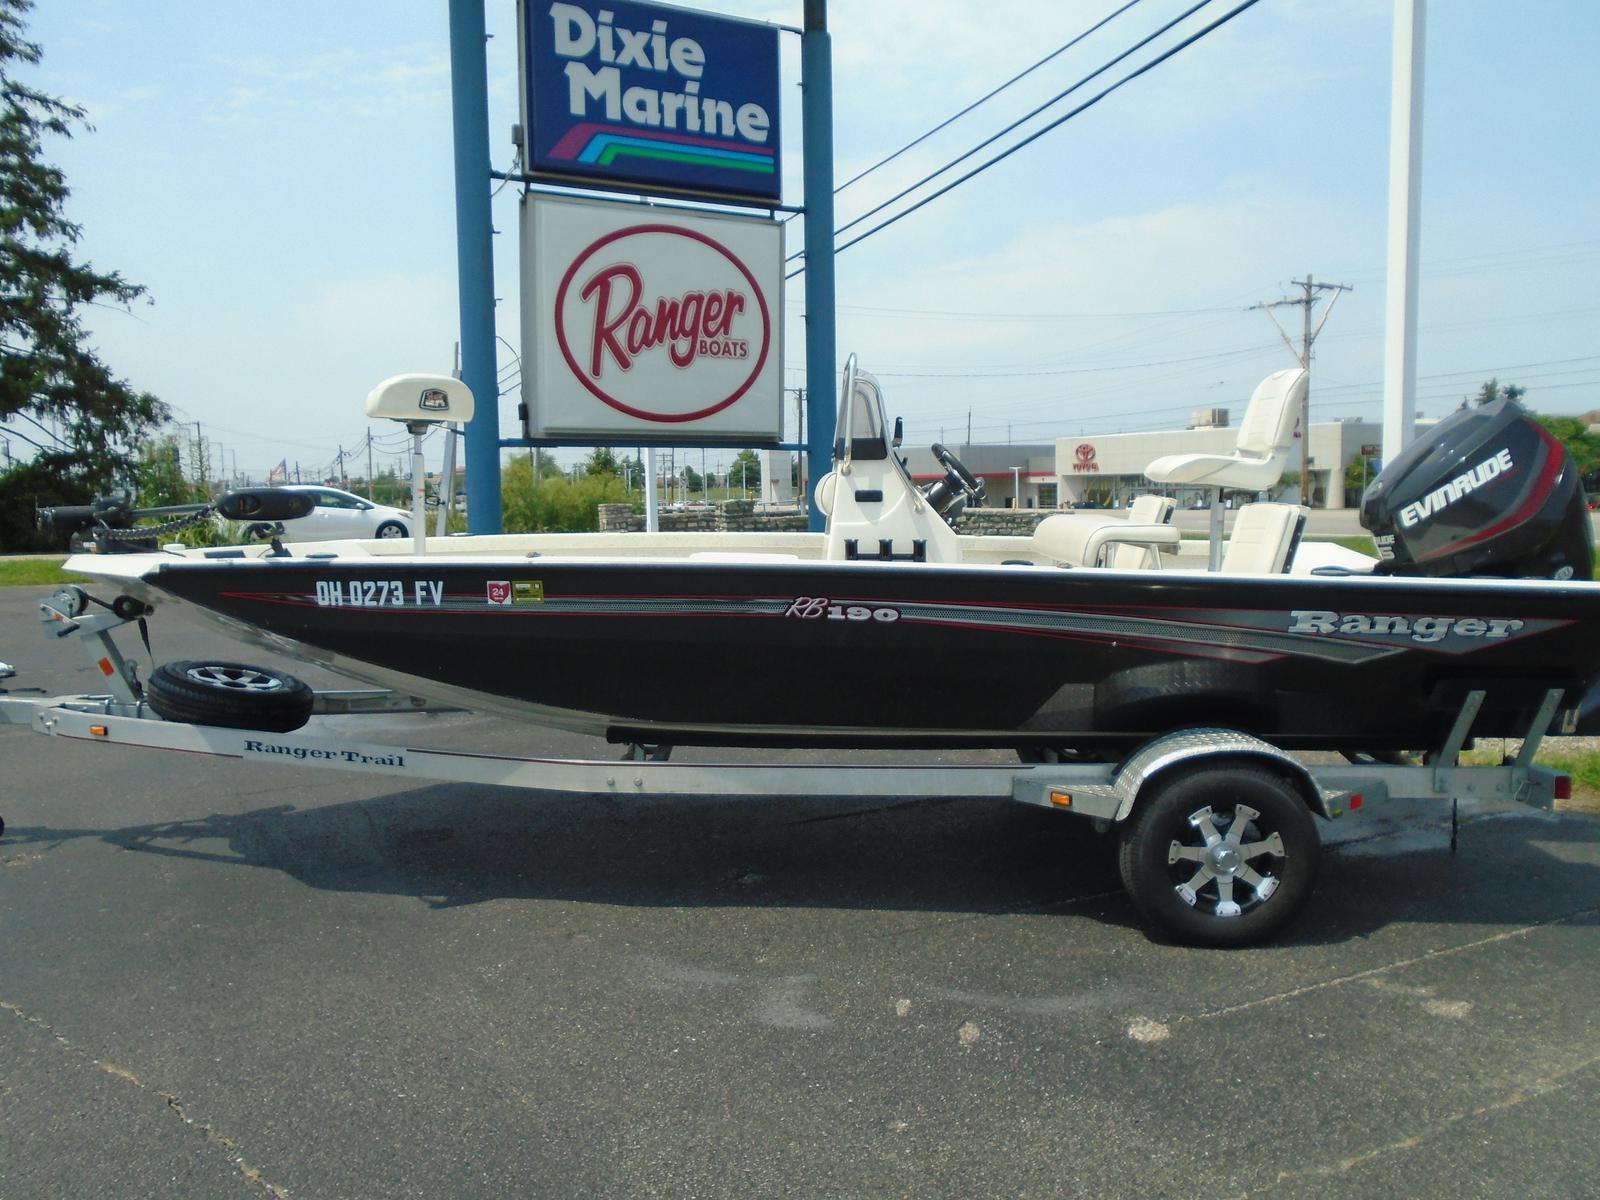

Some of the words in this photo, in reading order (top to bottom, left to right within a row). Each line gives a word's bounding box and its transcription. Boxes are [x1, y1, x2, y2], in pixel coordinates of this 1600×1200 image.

[549, 3, 706, 78] Dixie
[564, 61, 770, 143] Marine
[580, 263, 745, 378] Ranger
[700, 340, 748, 358] BOATS
[1400, 447, 1514, 527] EVINRUDE
[315, 580, 343, 606] OH
[349, 580, 405, 606] 0273
[415, 580, 444, 605] FV
[1287, 610, 1524, 642] Ranger
